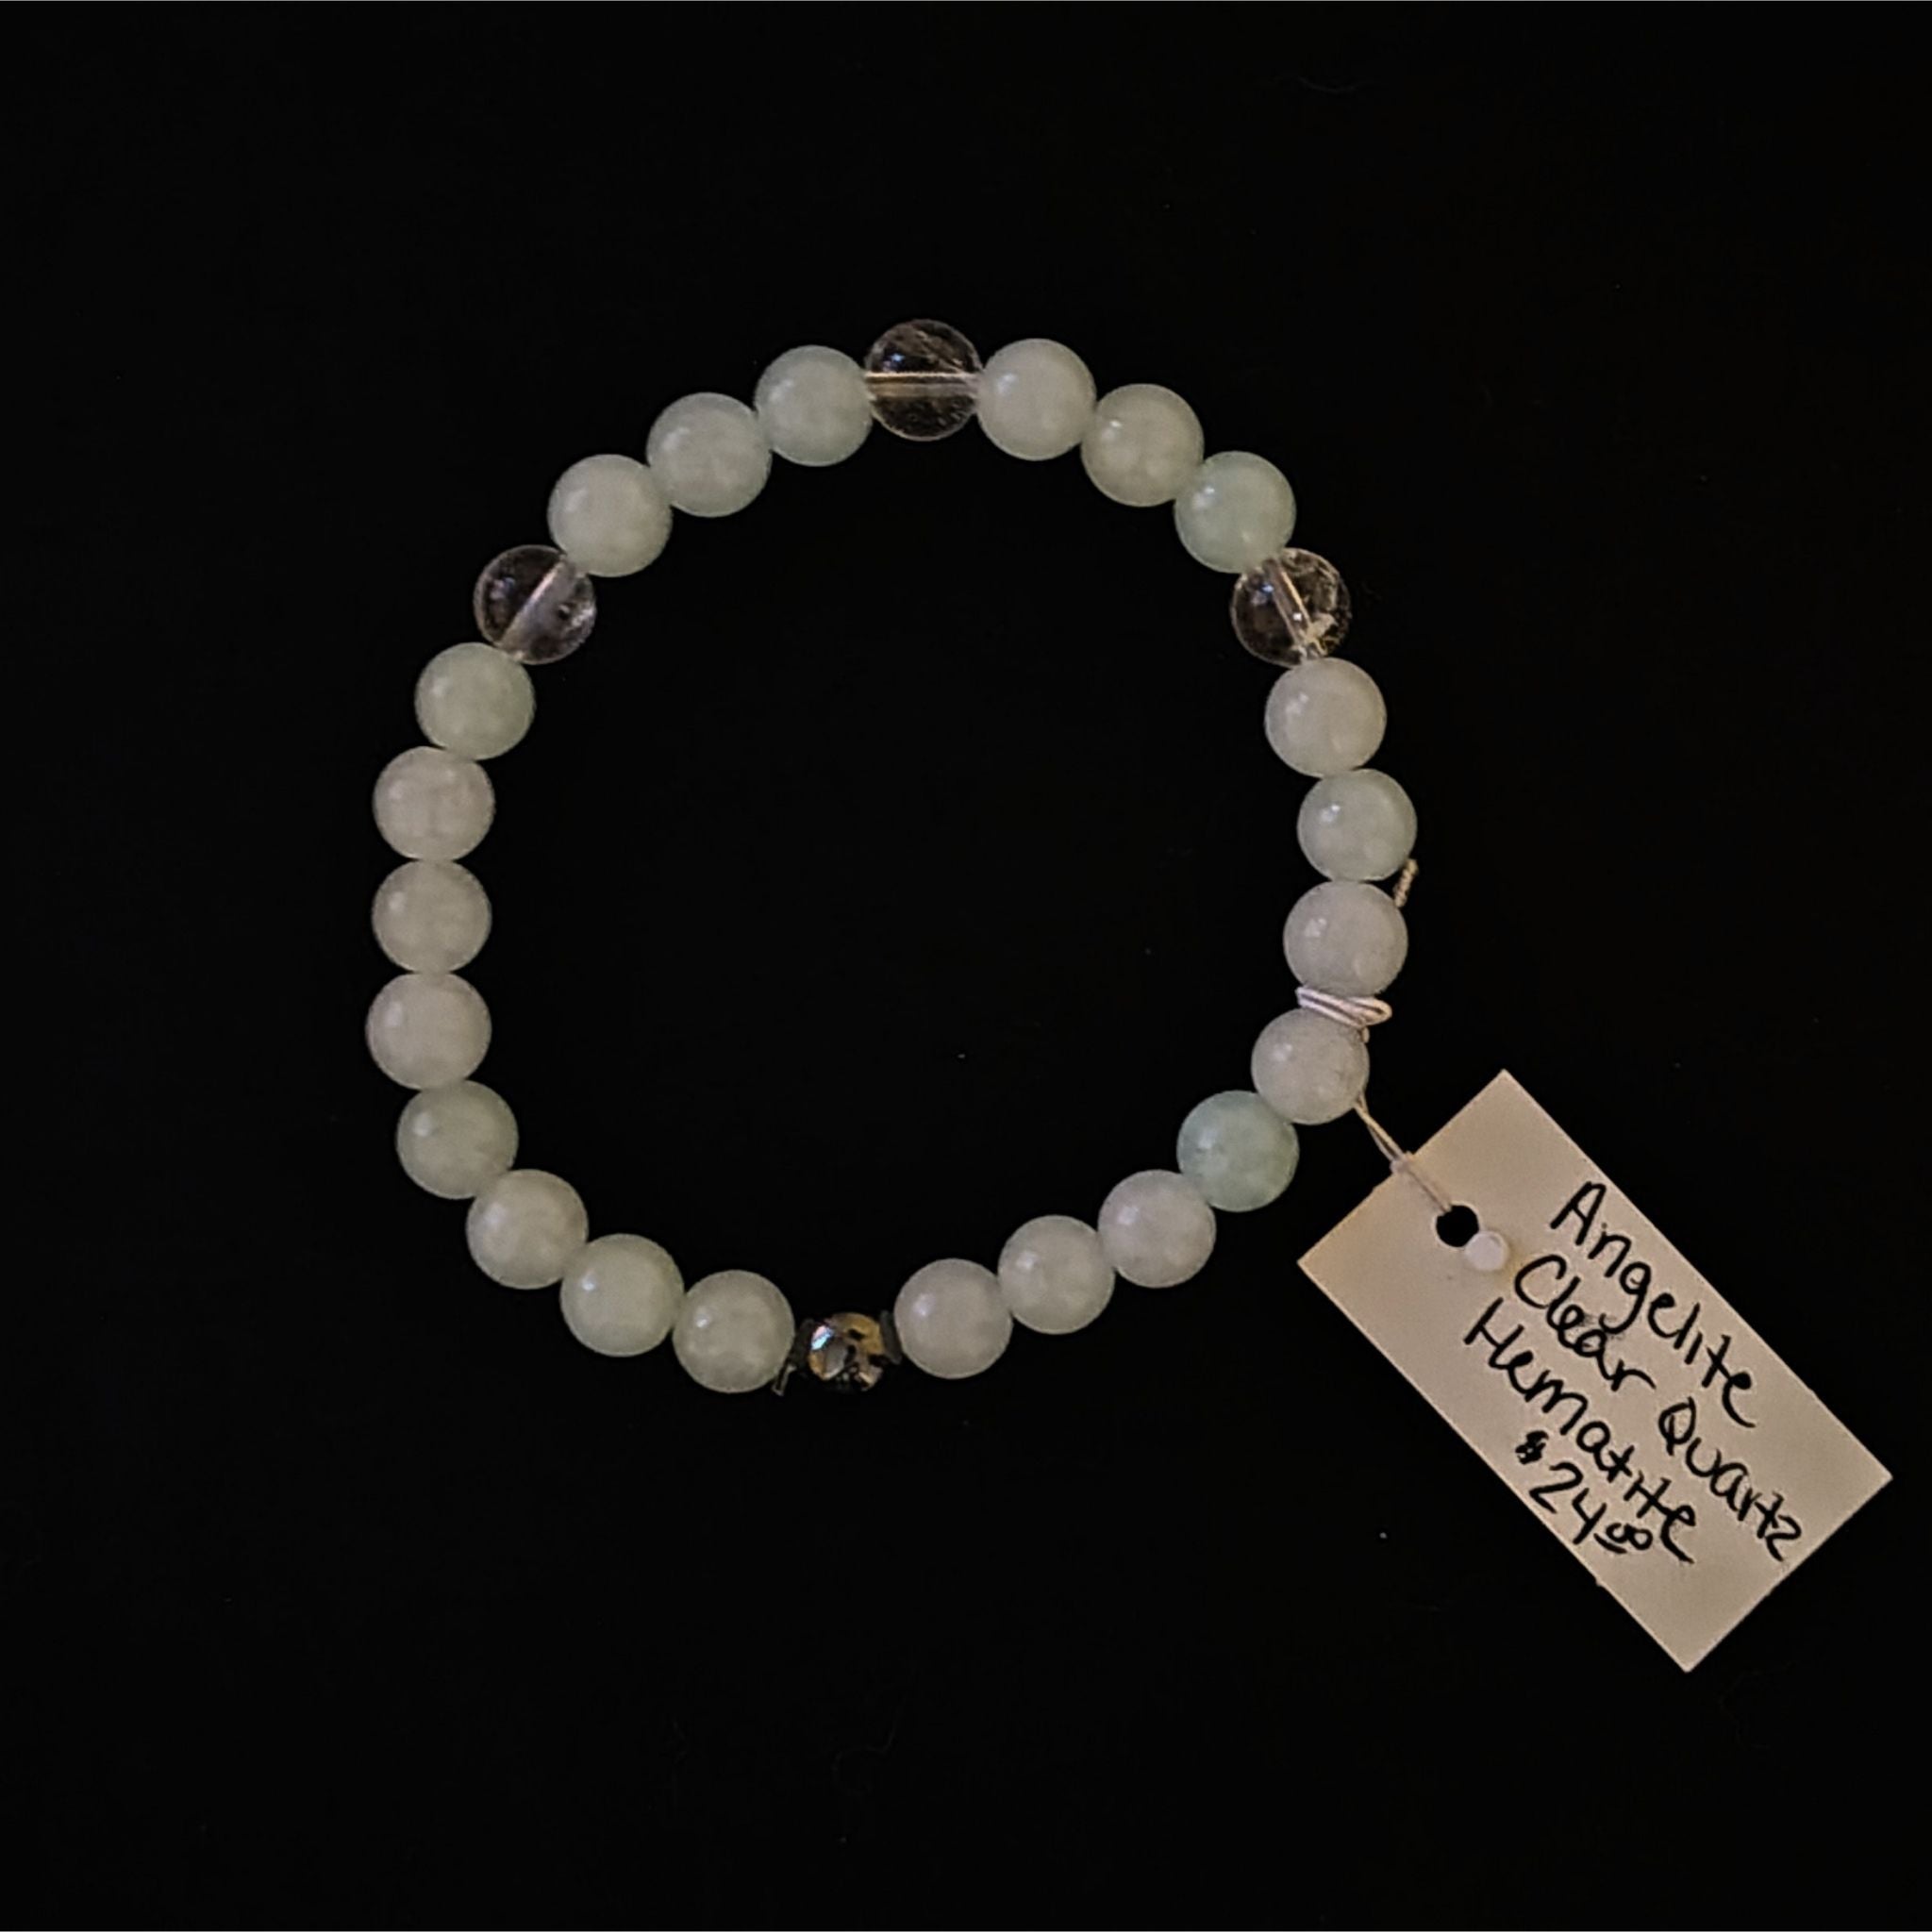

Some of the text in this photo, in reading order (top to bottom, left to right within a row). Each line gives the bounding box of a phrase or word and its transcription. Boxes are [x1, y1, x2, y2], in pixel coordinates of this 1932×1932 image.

[1462, 1296, 1697, 1565] Hematite
[1513, 1254, 1803, 1562] Clear Quartz
[1549, 1180, 1756, 1428] Angelite
